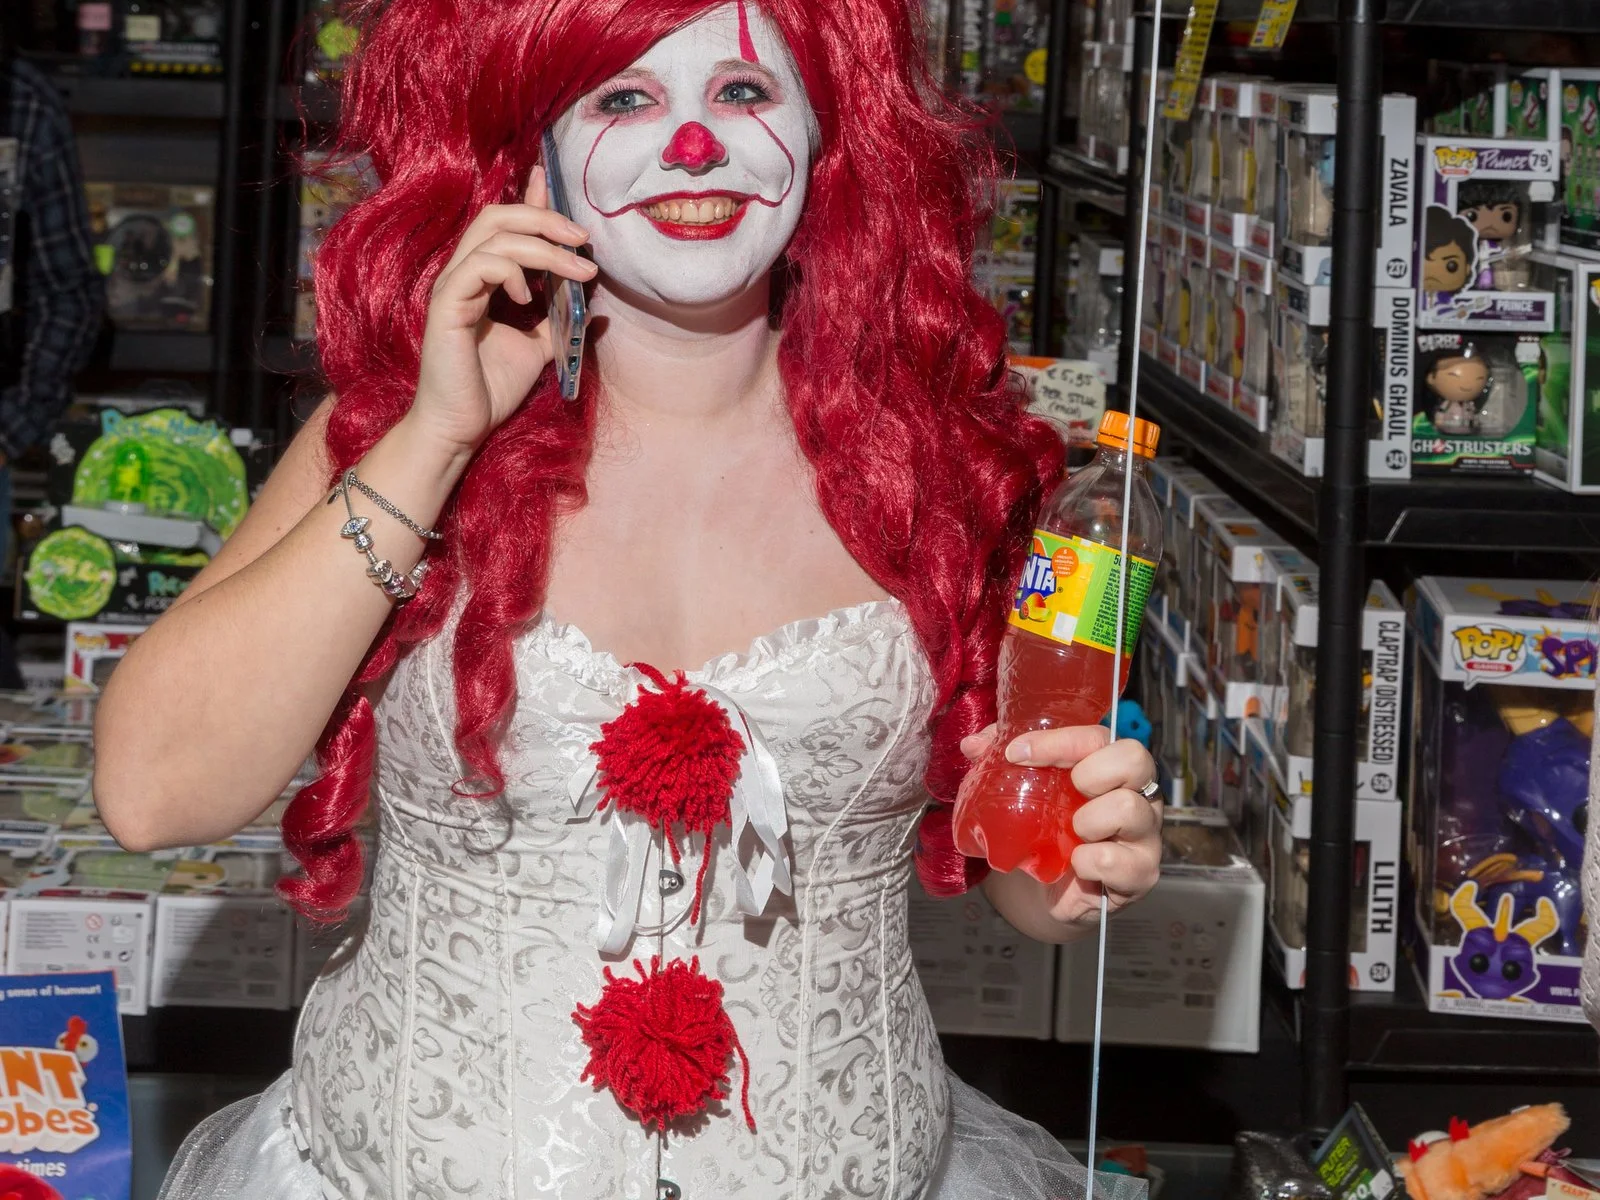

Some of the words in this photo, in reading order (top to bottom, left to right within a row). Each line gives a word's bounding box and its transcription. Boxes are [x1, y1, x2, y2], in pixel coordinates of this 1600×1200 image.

[1435, 147, 1477, 168] POP!
[1531, 154, 1548, 168] 79
[1389, 157, 1408, 227] ZAVALA
[1495, 299, 1534, 312] PRINCE
[1390, 297, 1410, 377] DOMINUS
[1388, 384, 1408, 440] GHAUL
[1375, 620, 1400, 683] CLAPTRAP
[1452, 626, 1526, 661] POP!
[1371, 684, 1398, 765] (DISTRESSED)
[1372, 860, 1394, 934] LILITH
[39, 984, 52, 996] of
[53, 983, 102, 996] humour!
[0, 1050, 82, 1100] NT
